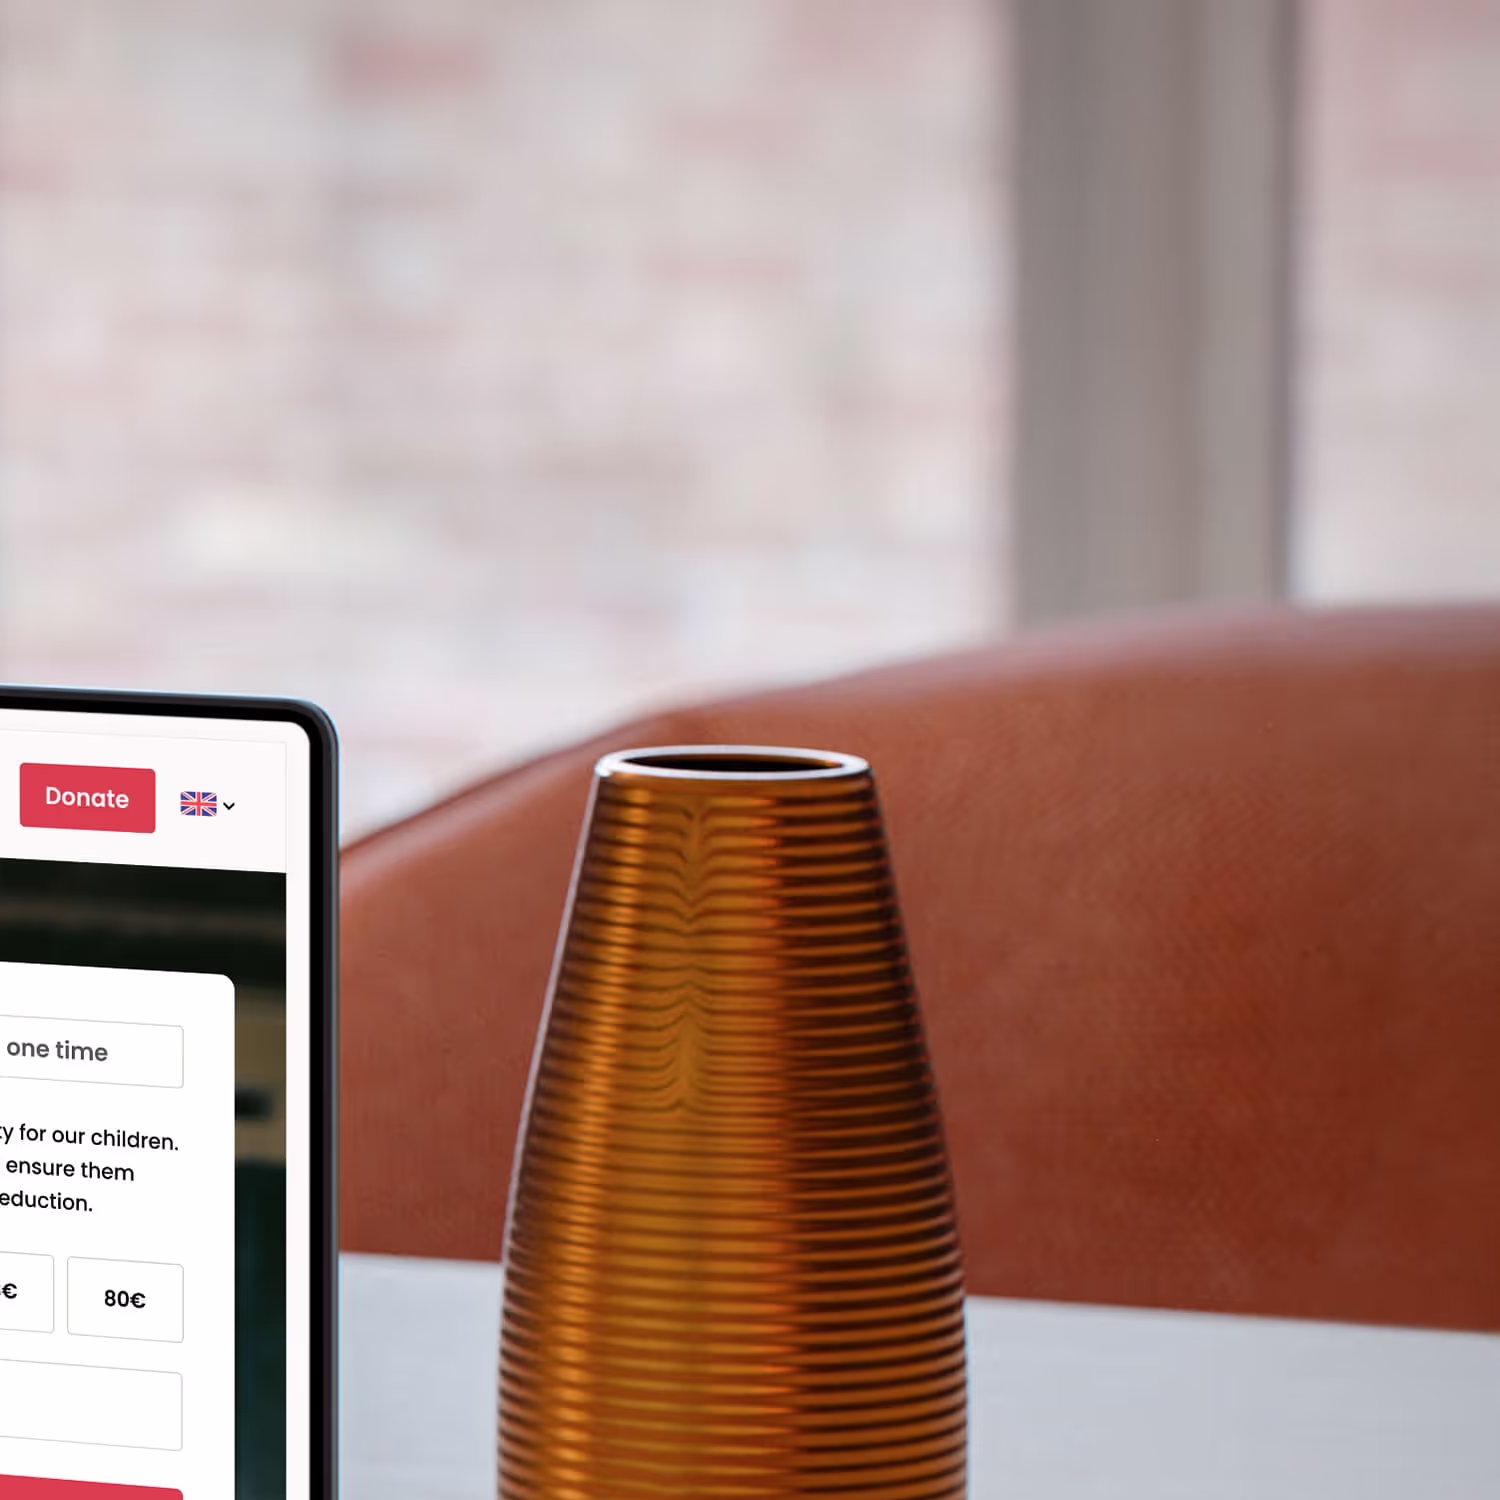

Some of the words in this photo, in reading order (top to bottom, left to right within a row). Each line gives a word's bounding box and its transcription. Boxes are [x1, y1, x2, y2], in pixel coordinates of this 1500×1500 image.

[46, 786, 129, 809] Donate
[6, 1041, 50, 1058] one
[55, 1039, 108, 1062] time
[18, 1122, 47, 1142] for
[51, 1129, 86, 1145] our
[90, 1128, 179, 1151] children.
[5, 1159, 76, 1178] ensure
[80, 1161, 135, 1182] them
[104, 1289, 146, 1309] 80€
